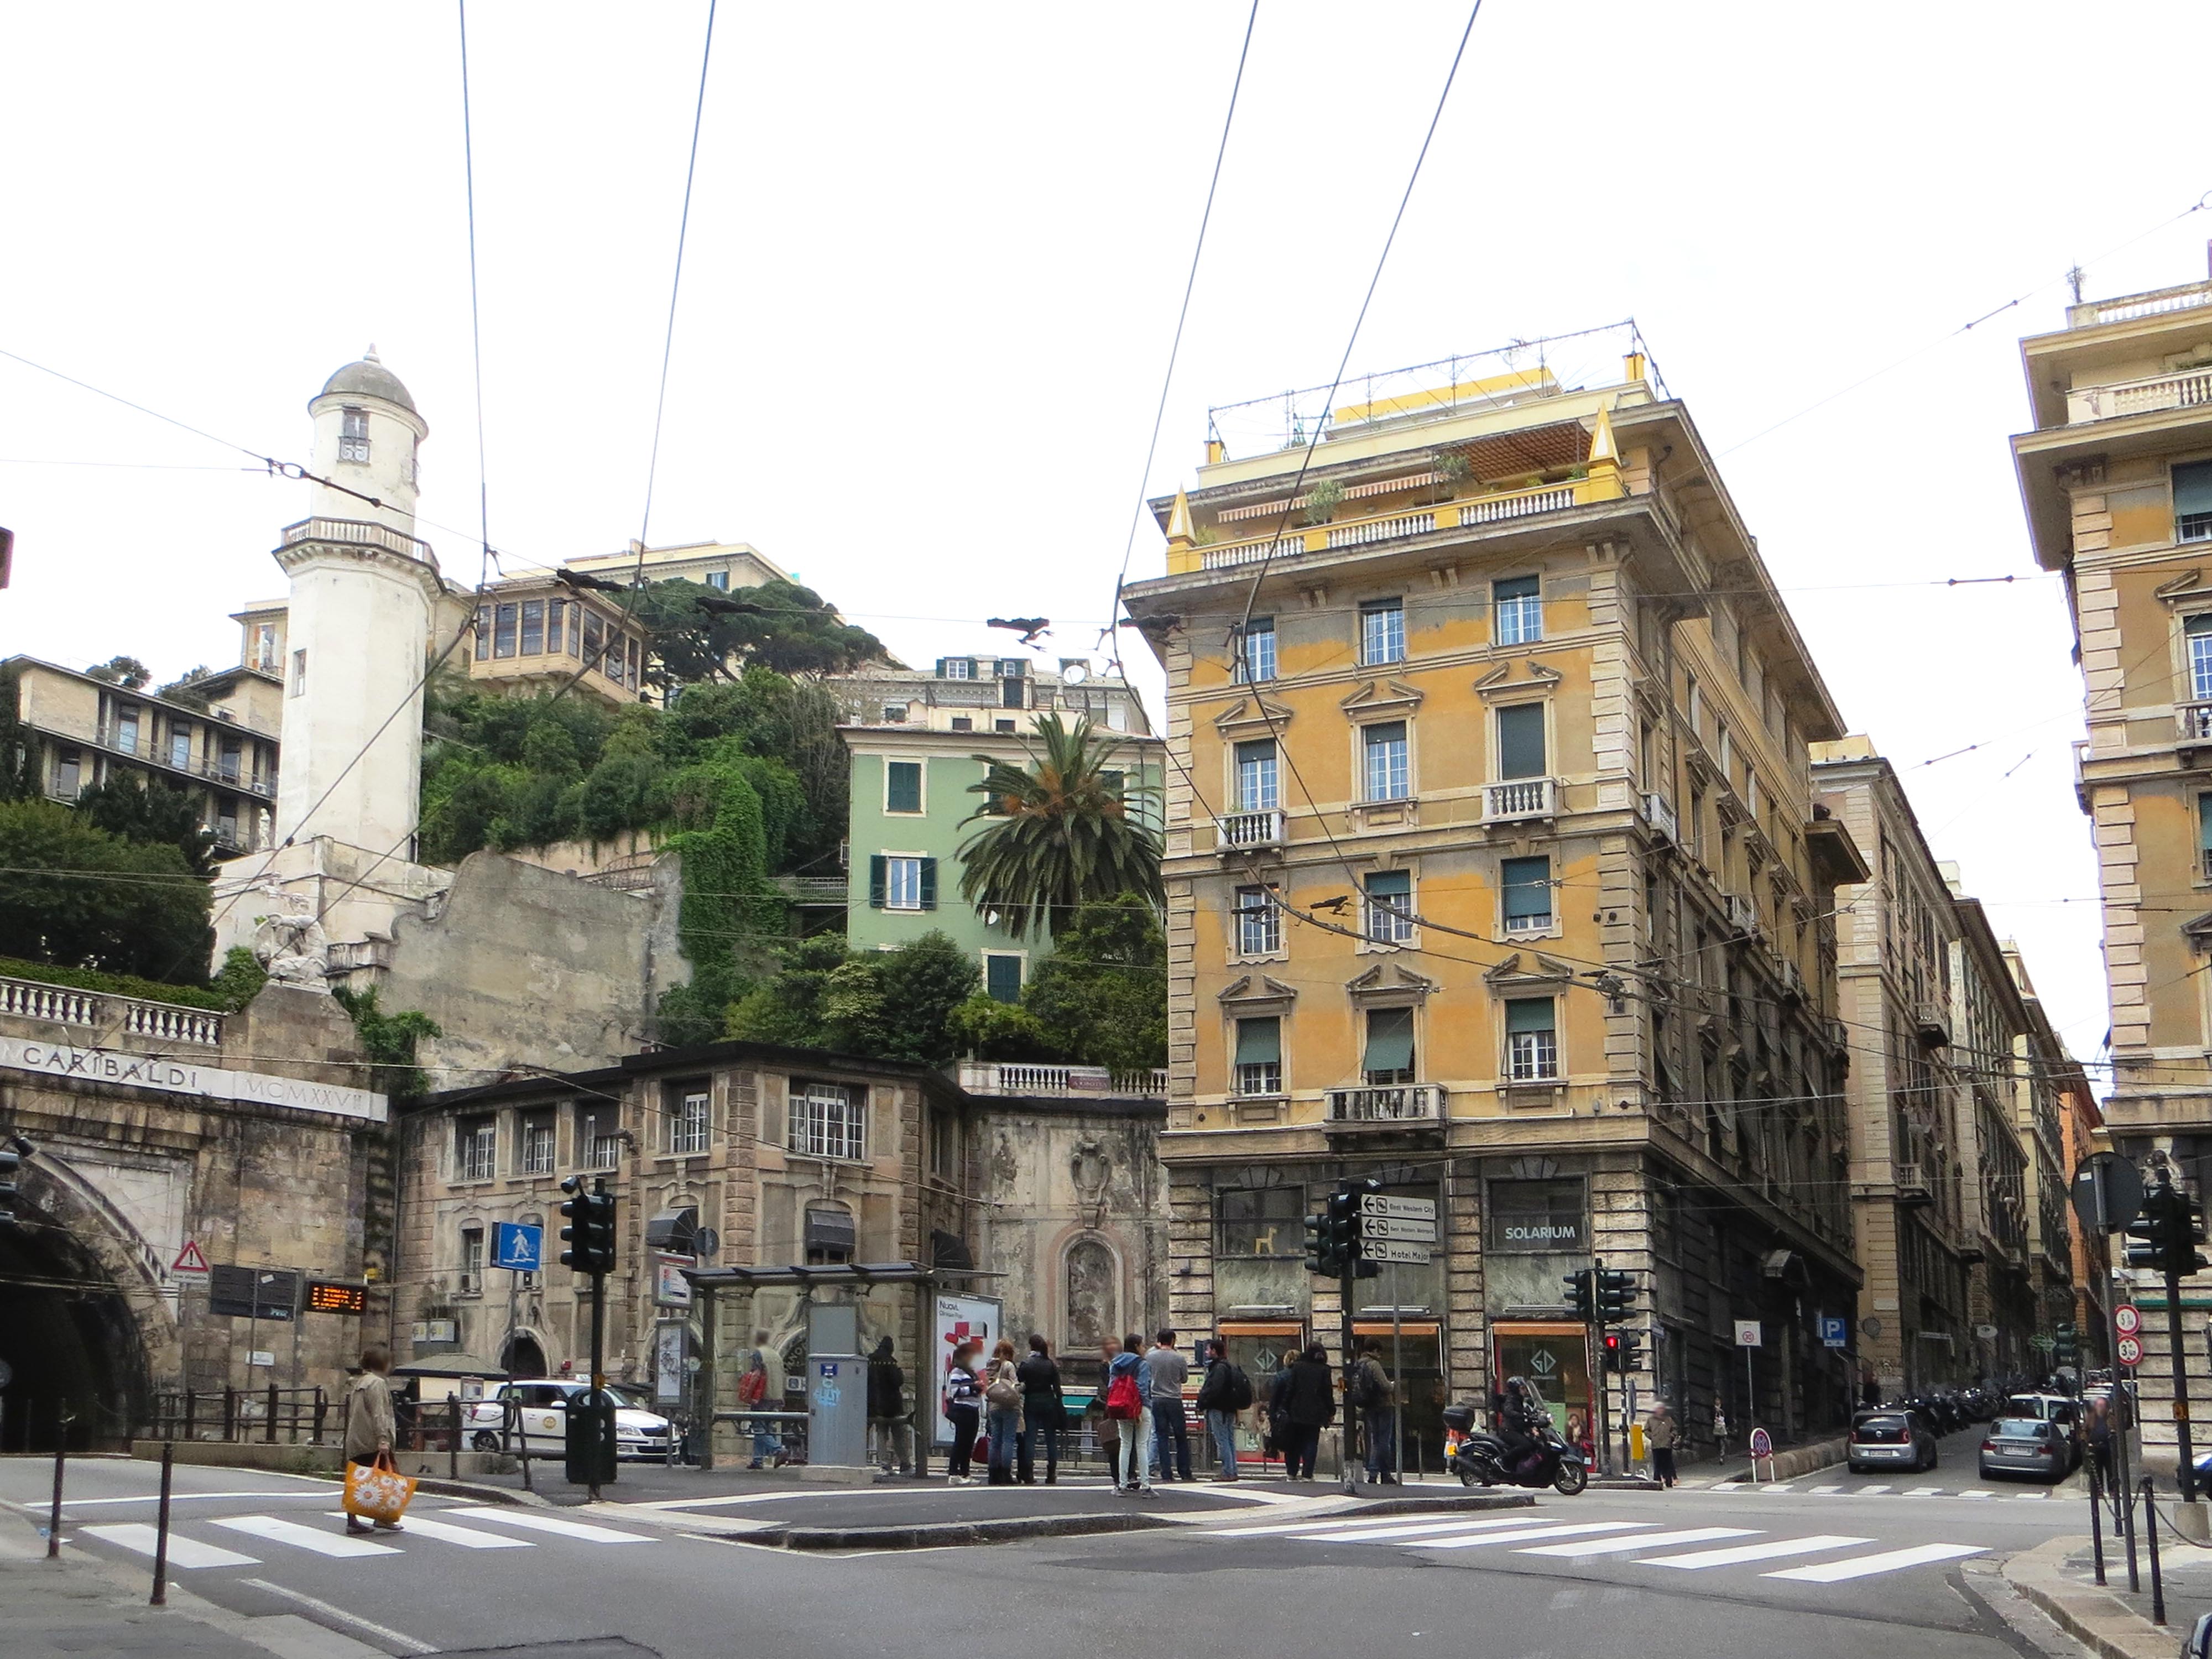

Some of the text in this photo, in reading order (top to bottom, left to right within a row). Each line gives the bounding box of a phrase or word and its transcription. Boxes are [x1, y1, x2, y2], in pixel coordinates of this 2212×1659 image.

[23, 1047, 196, 1088] GARIBALDI
[1424, 1206, 1434, 1214] City
[1505, 1226, 1575, 1239] SOLARIUM
[1391, 1250, 1428, 1261] Hotel Major
[1827, 1321, 1840, 1337] P
